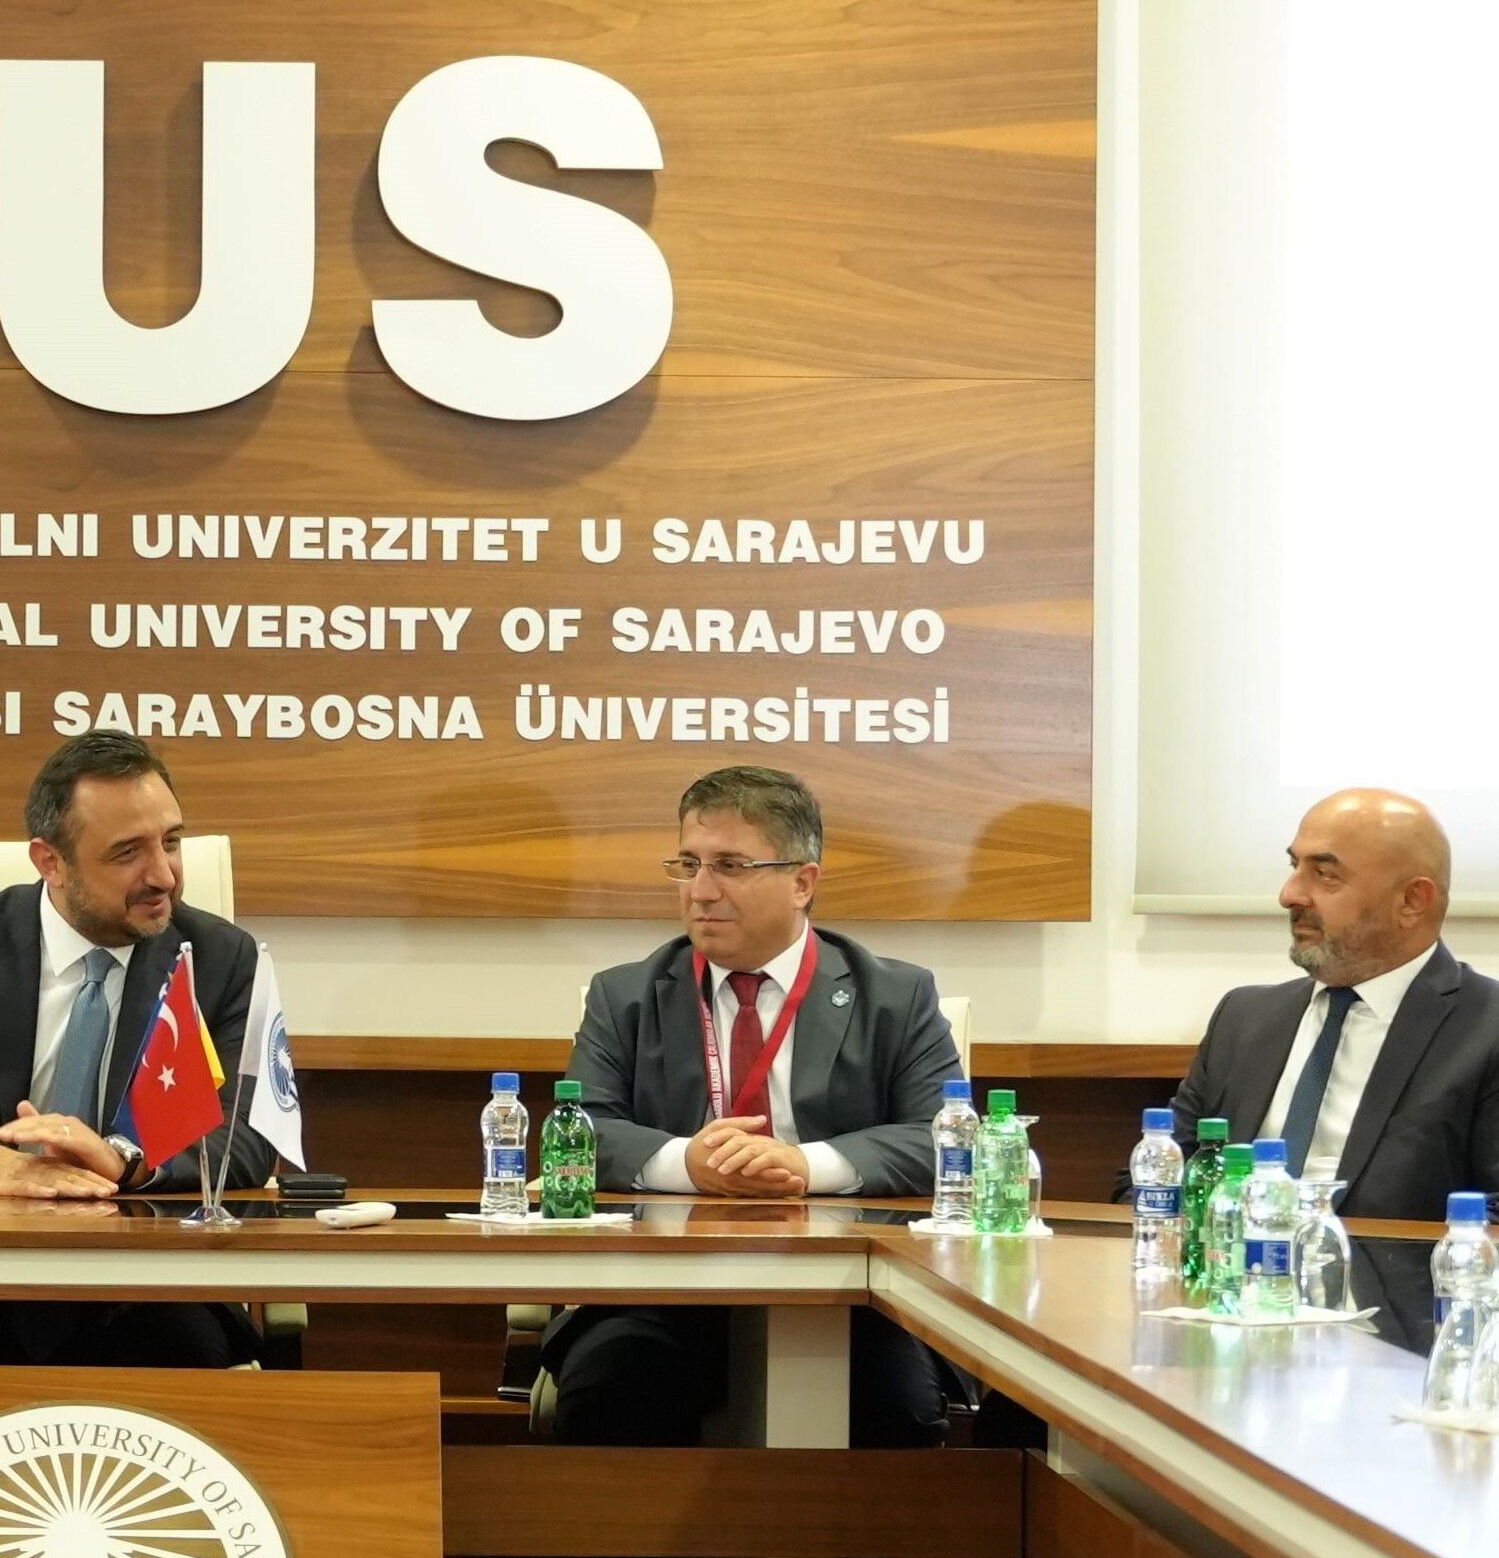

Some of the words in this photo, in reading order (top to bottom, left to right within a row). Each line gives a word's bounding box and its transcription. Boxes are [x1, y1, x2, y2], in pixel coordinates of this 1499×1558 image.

[132, 514, 550, 562] UNIVERZITET
[580, 518, 622, 564] U
[652, 517, 986, 565] SARAJEVU
[90, 603, 472, 651] UNIVERSITY
[500, 606, 582, 653] OF
[611, 606, 951, 655] SARAJEVO
[53, 691, 484, 740] SARAYBOSNA
[2, 1422, 207, 1482] UNIVERSITY
[200, 1479, 245, 1519] OF
